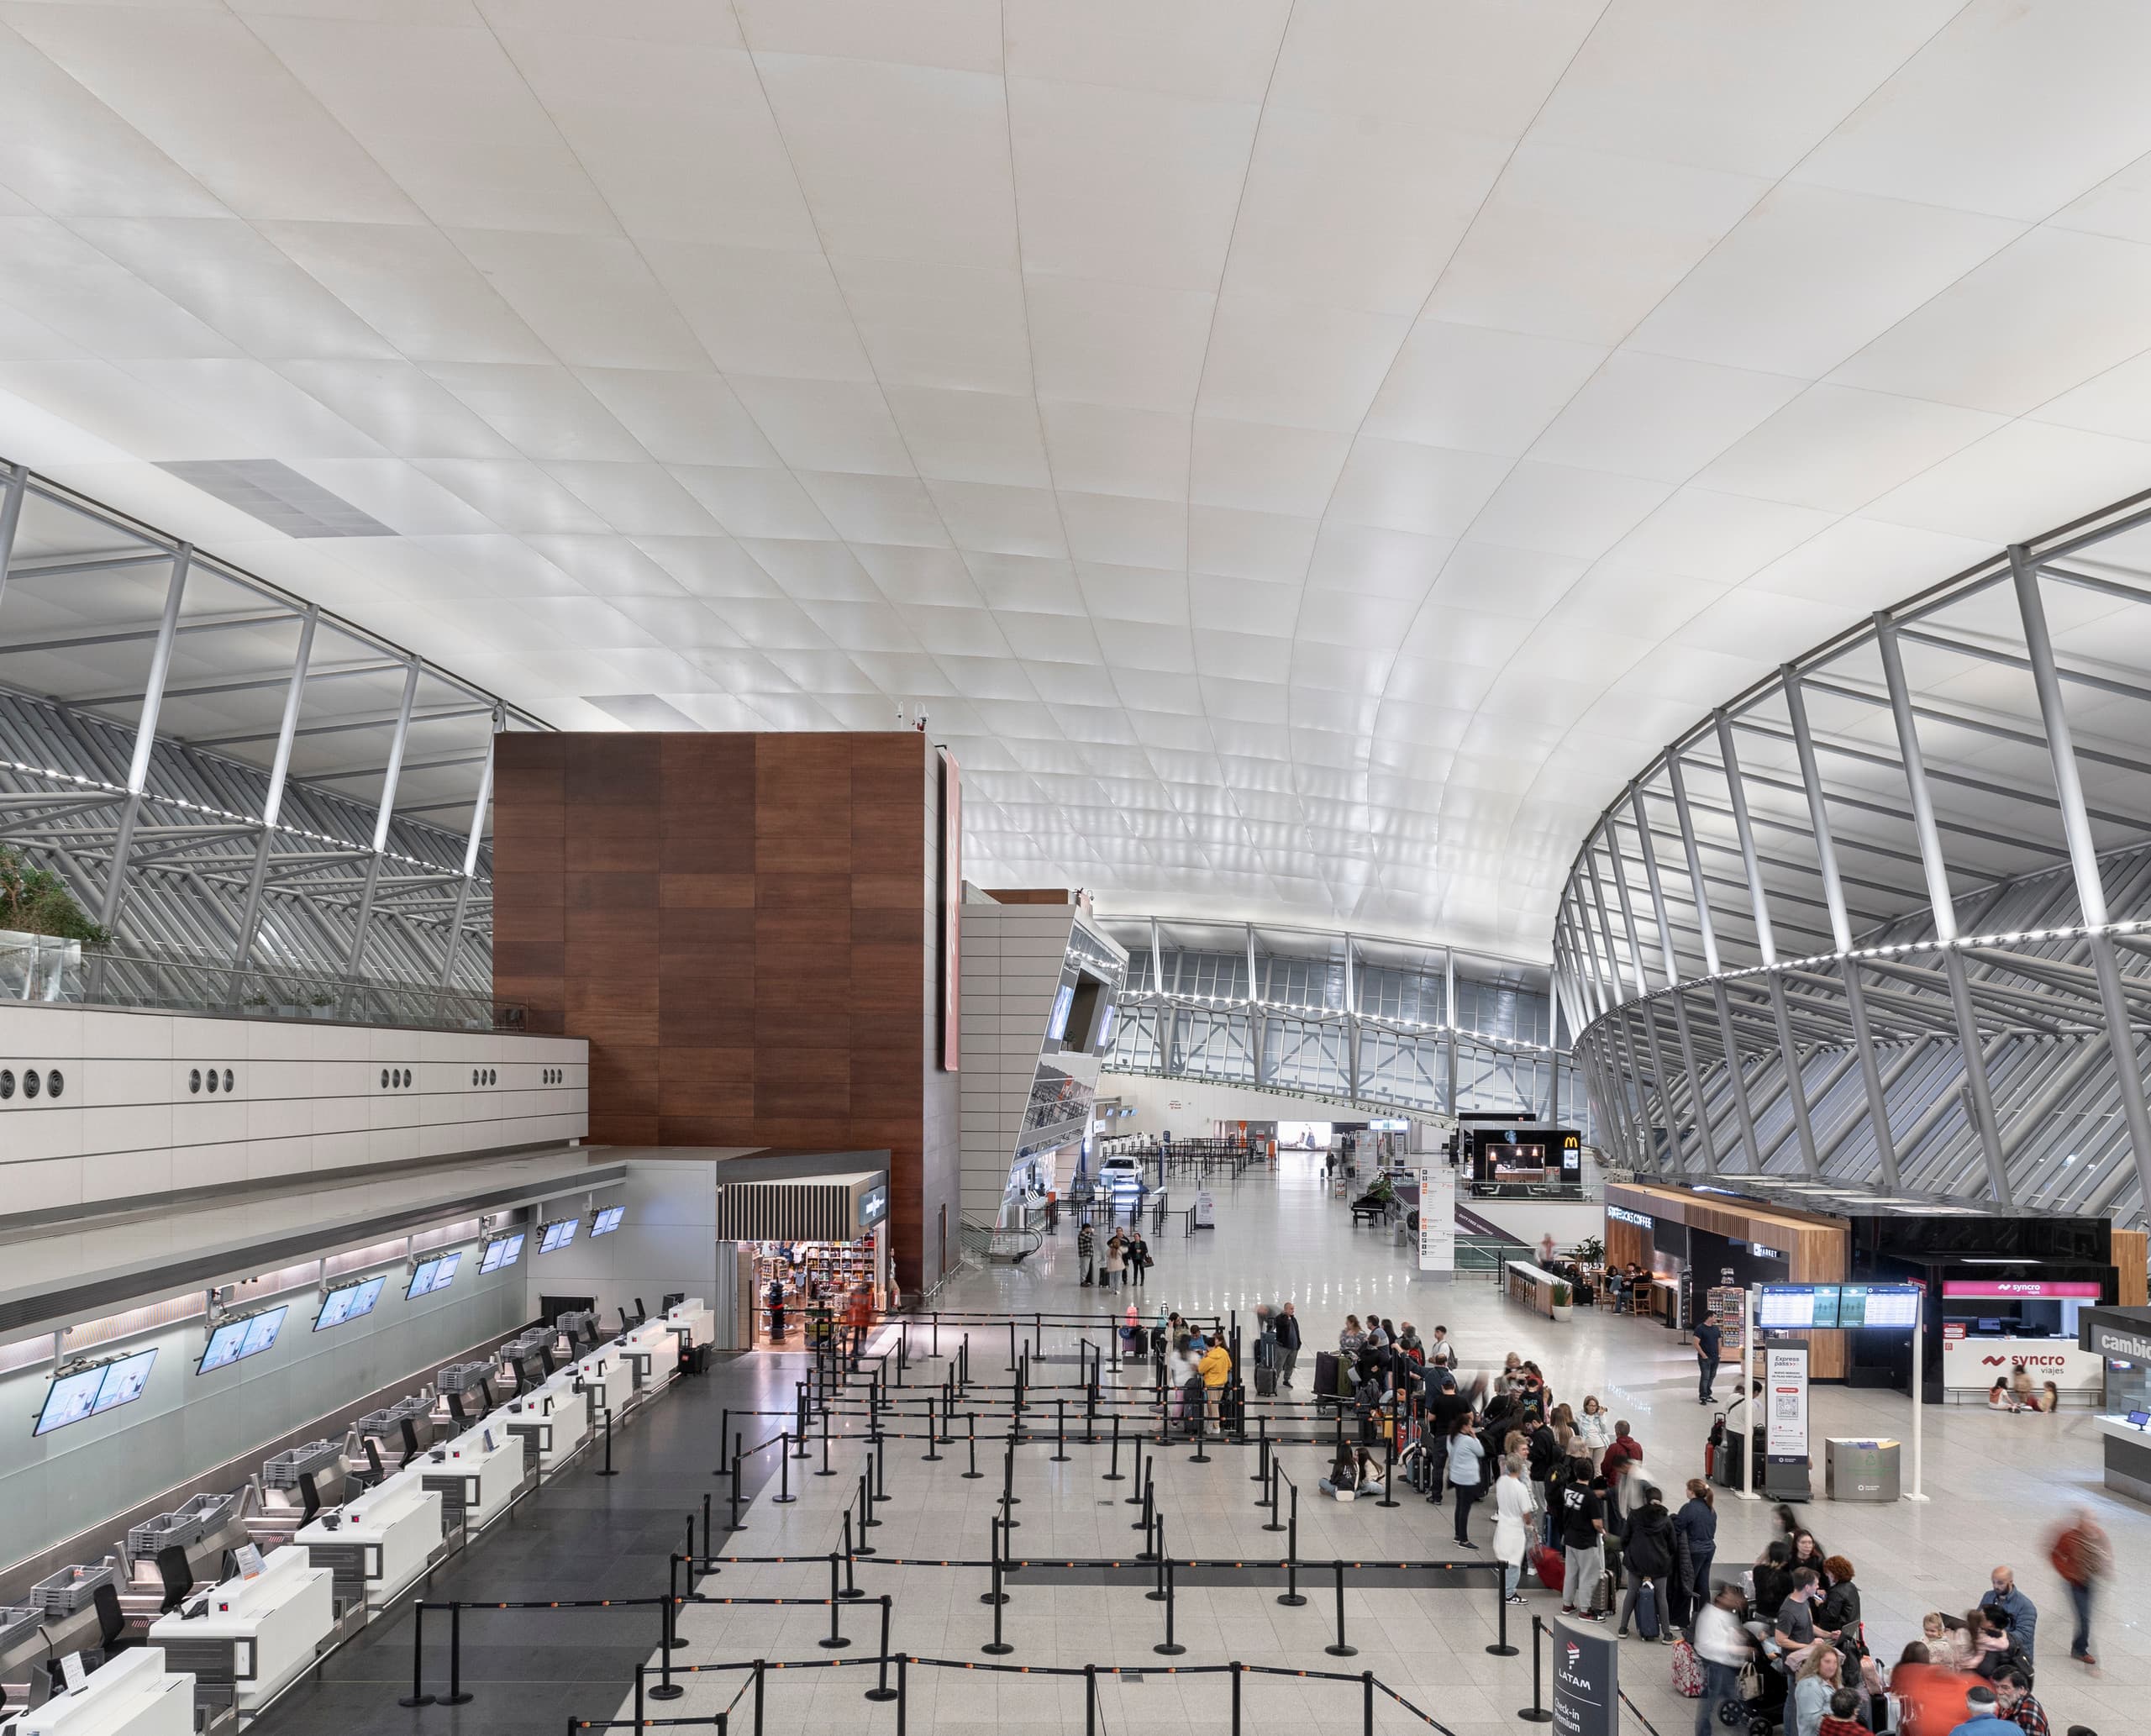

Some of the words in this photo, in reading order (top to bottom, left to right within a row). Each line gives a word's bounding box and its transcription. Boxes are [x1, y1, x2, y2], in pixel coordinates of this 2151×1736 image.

[1459, 1213, 1469, 1222] DUTY
[1468, 1218, 1477, 1227] FREE
[1633, 1213, 1652, 1228] COFFEE
[2012, 1284, 2041, 1292] syncro
[2011, 1355, 2065, 1367] syncro
[2040, 1366, 2064, 1376] viajes
[1559, 1667, 1591, 1691] LATAM
[1554, 1697, 1580, 1721] Check-in
[1554, 1707, 1580, 1733] Premium
